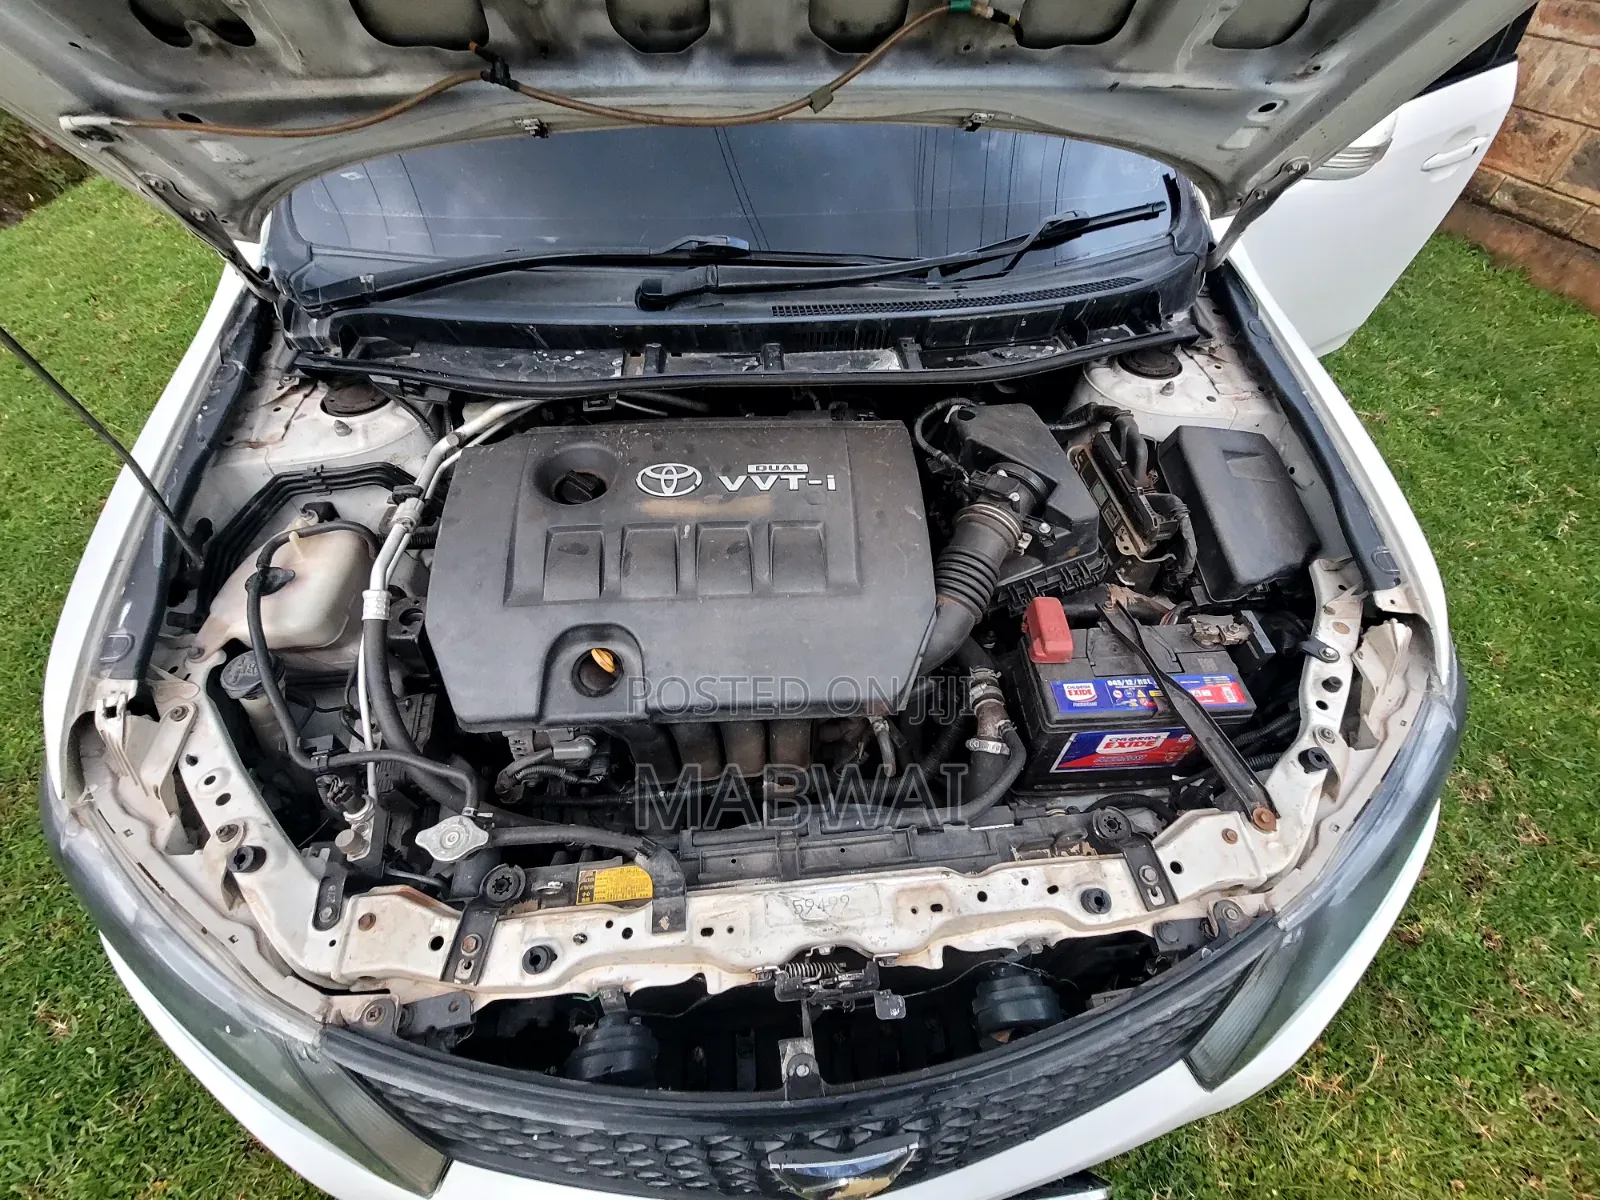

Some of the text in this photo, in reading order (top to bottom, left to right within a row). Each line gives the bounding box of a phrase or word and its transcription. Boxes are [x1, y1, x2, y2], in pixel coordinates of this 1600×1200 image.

[755, 464, 804, 472] DUAL
[718, 475, 836, 491] VVT-i
[1103, 741, 1157, 749] EXIDE
